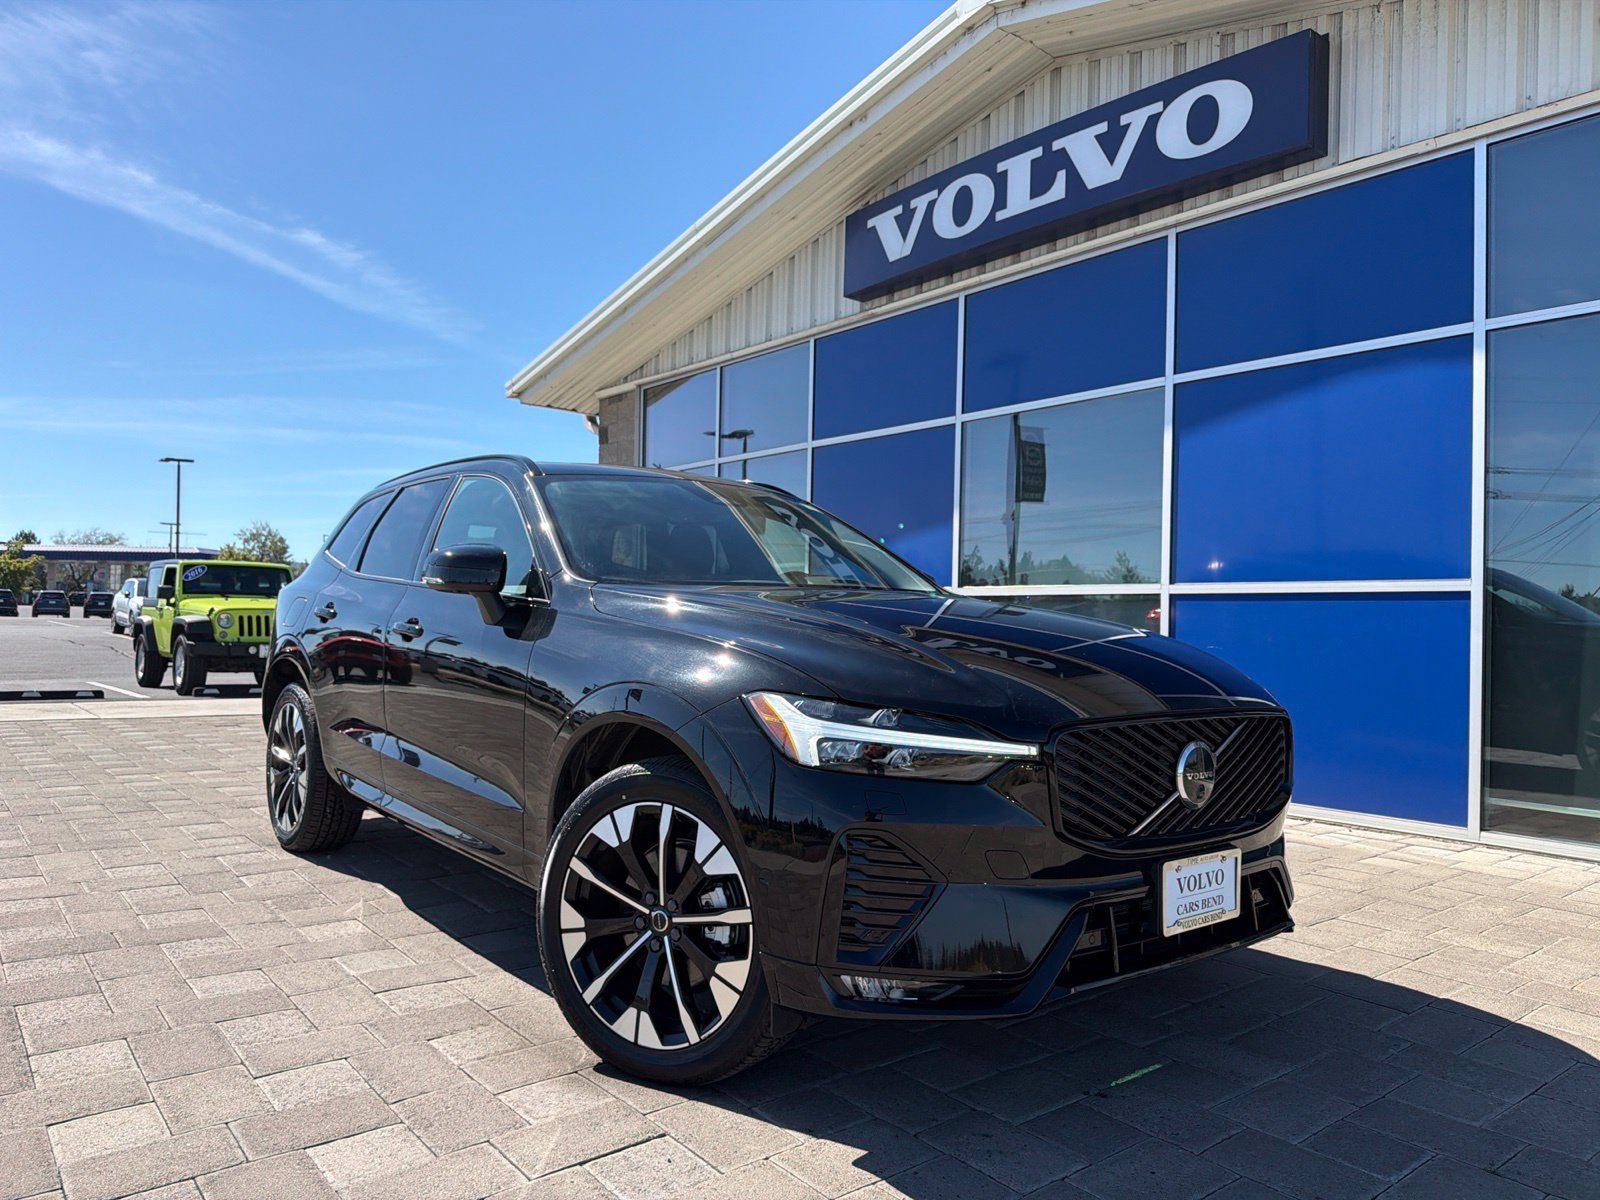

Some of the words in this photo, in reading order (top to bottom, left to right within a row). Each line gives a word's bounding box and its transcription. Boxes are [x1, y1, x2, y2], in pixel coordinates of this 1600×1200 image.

[867, 79, 1253, 262] VOLVO
[1185, 770, 1213, 780] VOLVO
[1176, 868, 1225, 894] VOLVO
[1176, 900, 1200, 916] CARS
[1201, 894, 1224, 910] BEND
[1181, 917, 1198, 930] VOLVO
[1198, 914, 1211, 925] CARS
